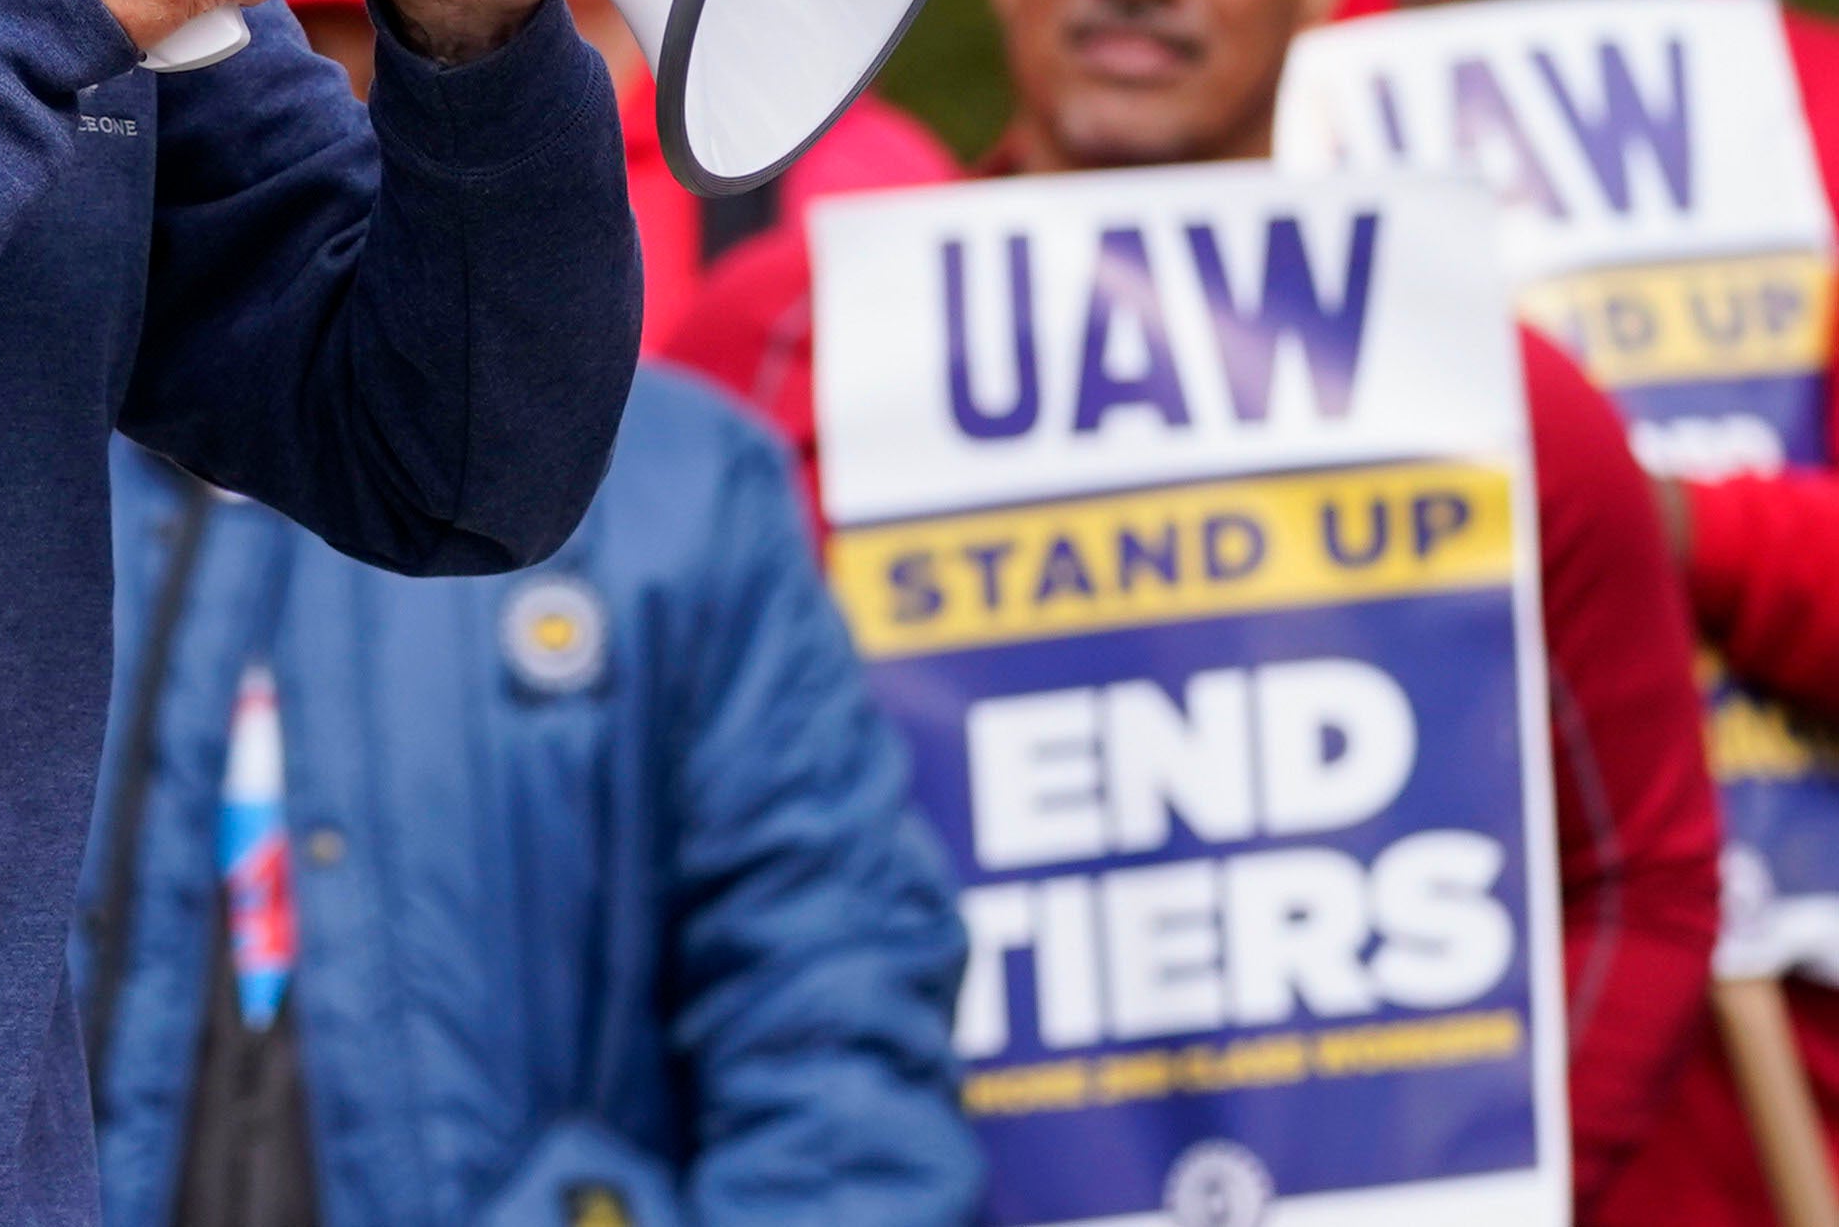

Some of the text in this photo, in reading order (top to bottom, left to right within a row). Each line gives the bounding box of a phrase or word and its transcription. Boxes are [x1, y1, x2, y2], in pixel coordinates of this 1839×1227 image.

[940, 210, 1383, 442] UAW
[884, 490, 1475, 624] STAND UP
[964, 656, 1418, 872] END
[953, 828, 1516, 1060] TIERS
